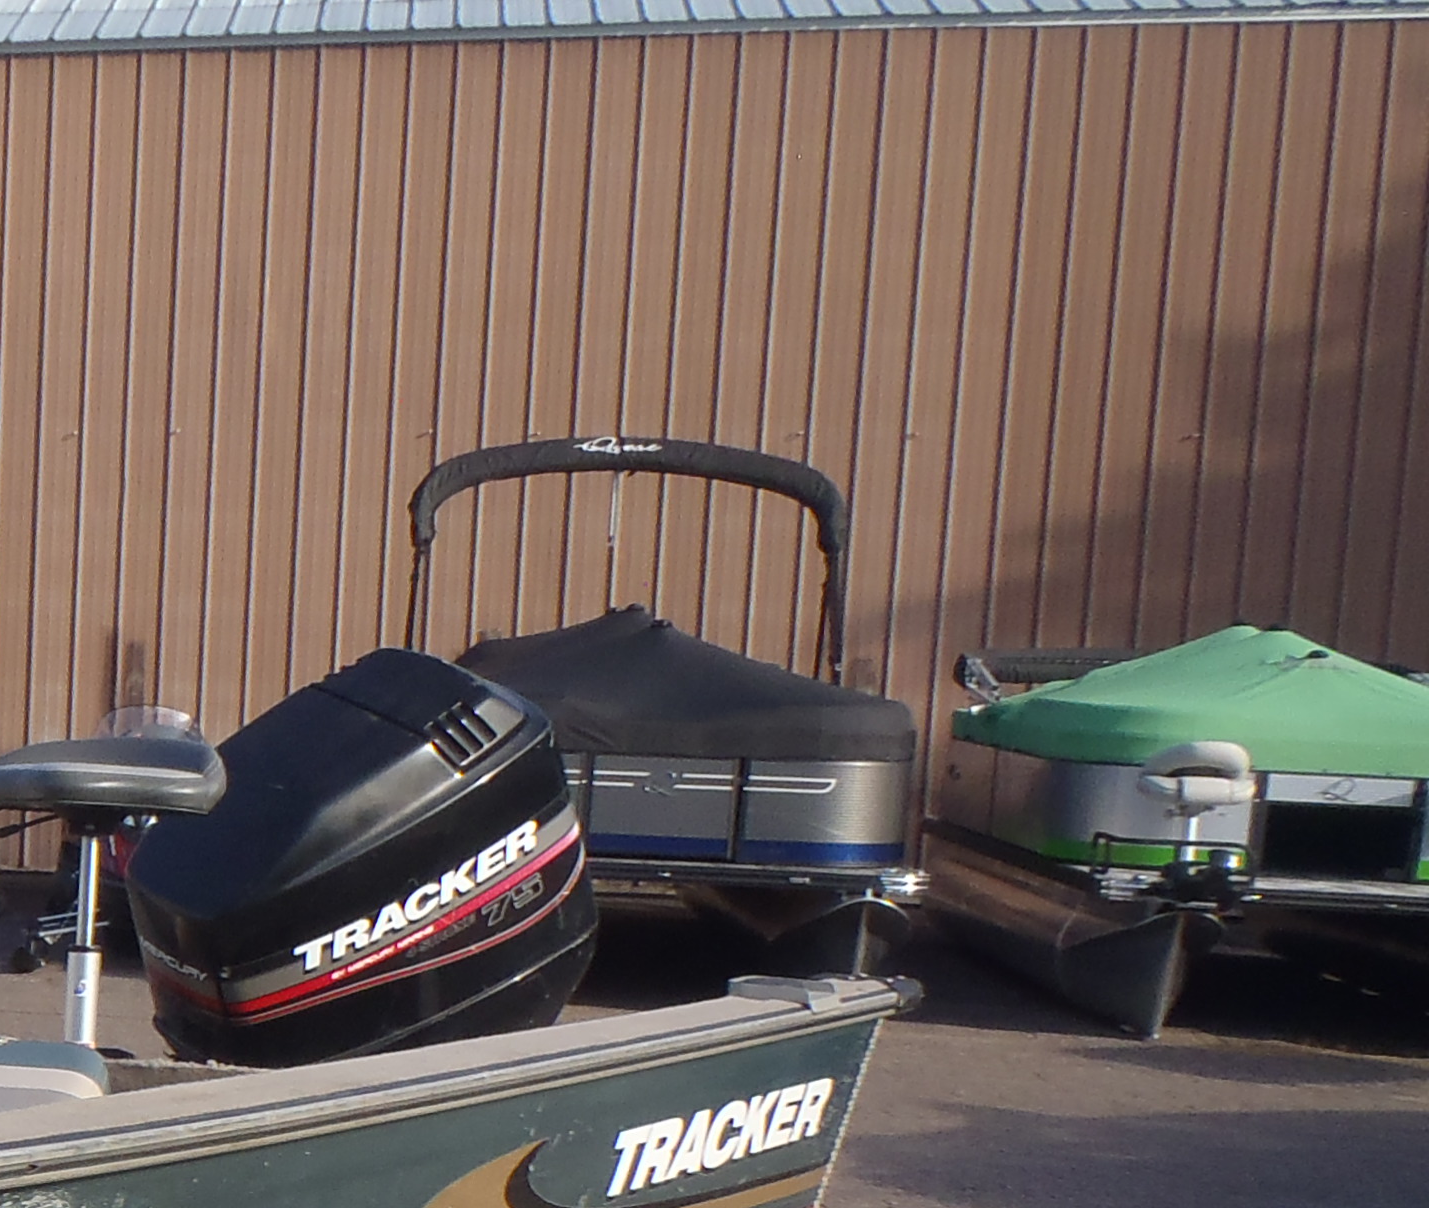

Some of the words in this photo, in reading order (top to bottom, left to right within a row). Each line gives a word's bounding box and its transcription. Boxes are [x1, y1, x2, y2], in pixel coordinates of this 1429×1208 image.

[293, 820, 539, 973] TRACKER
[481, 871, 544, 927] 75
[606, 1077, 834, 1199] TRACKER
